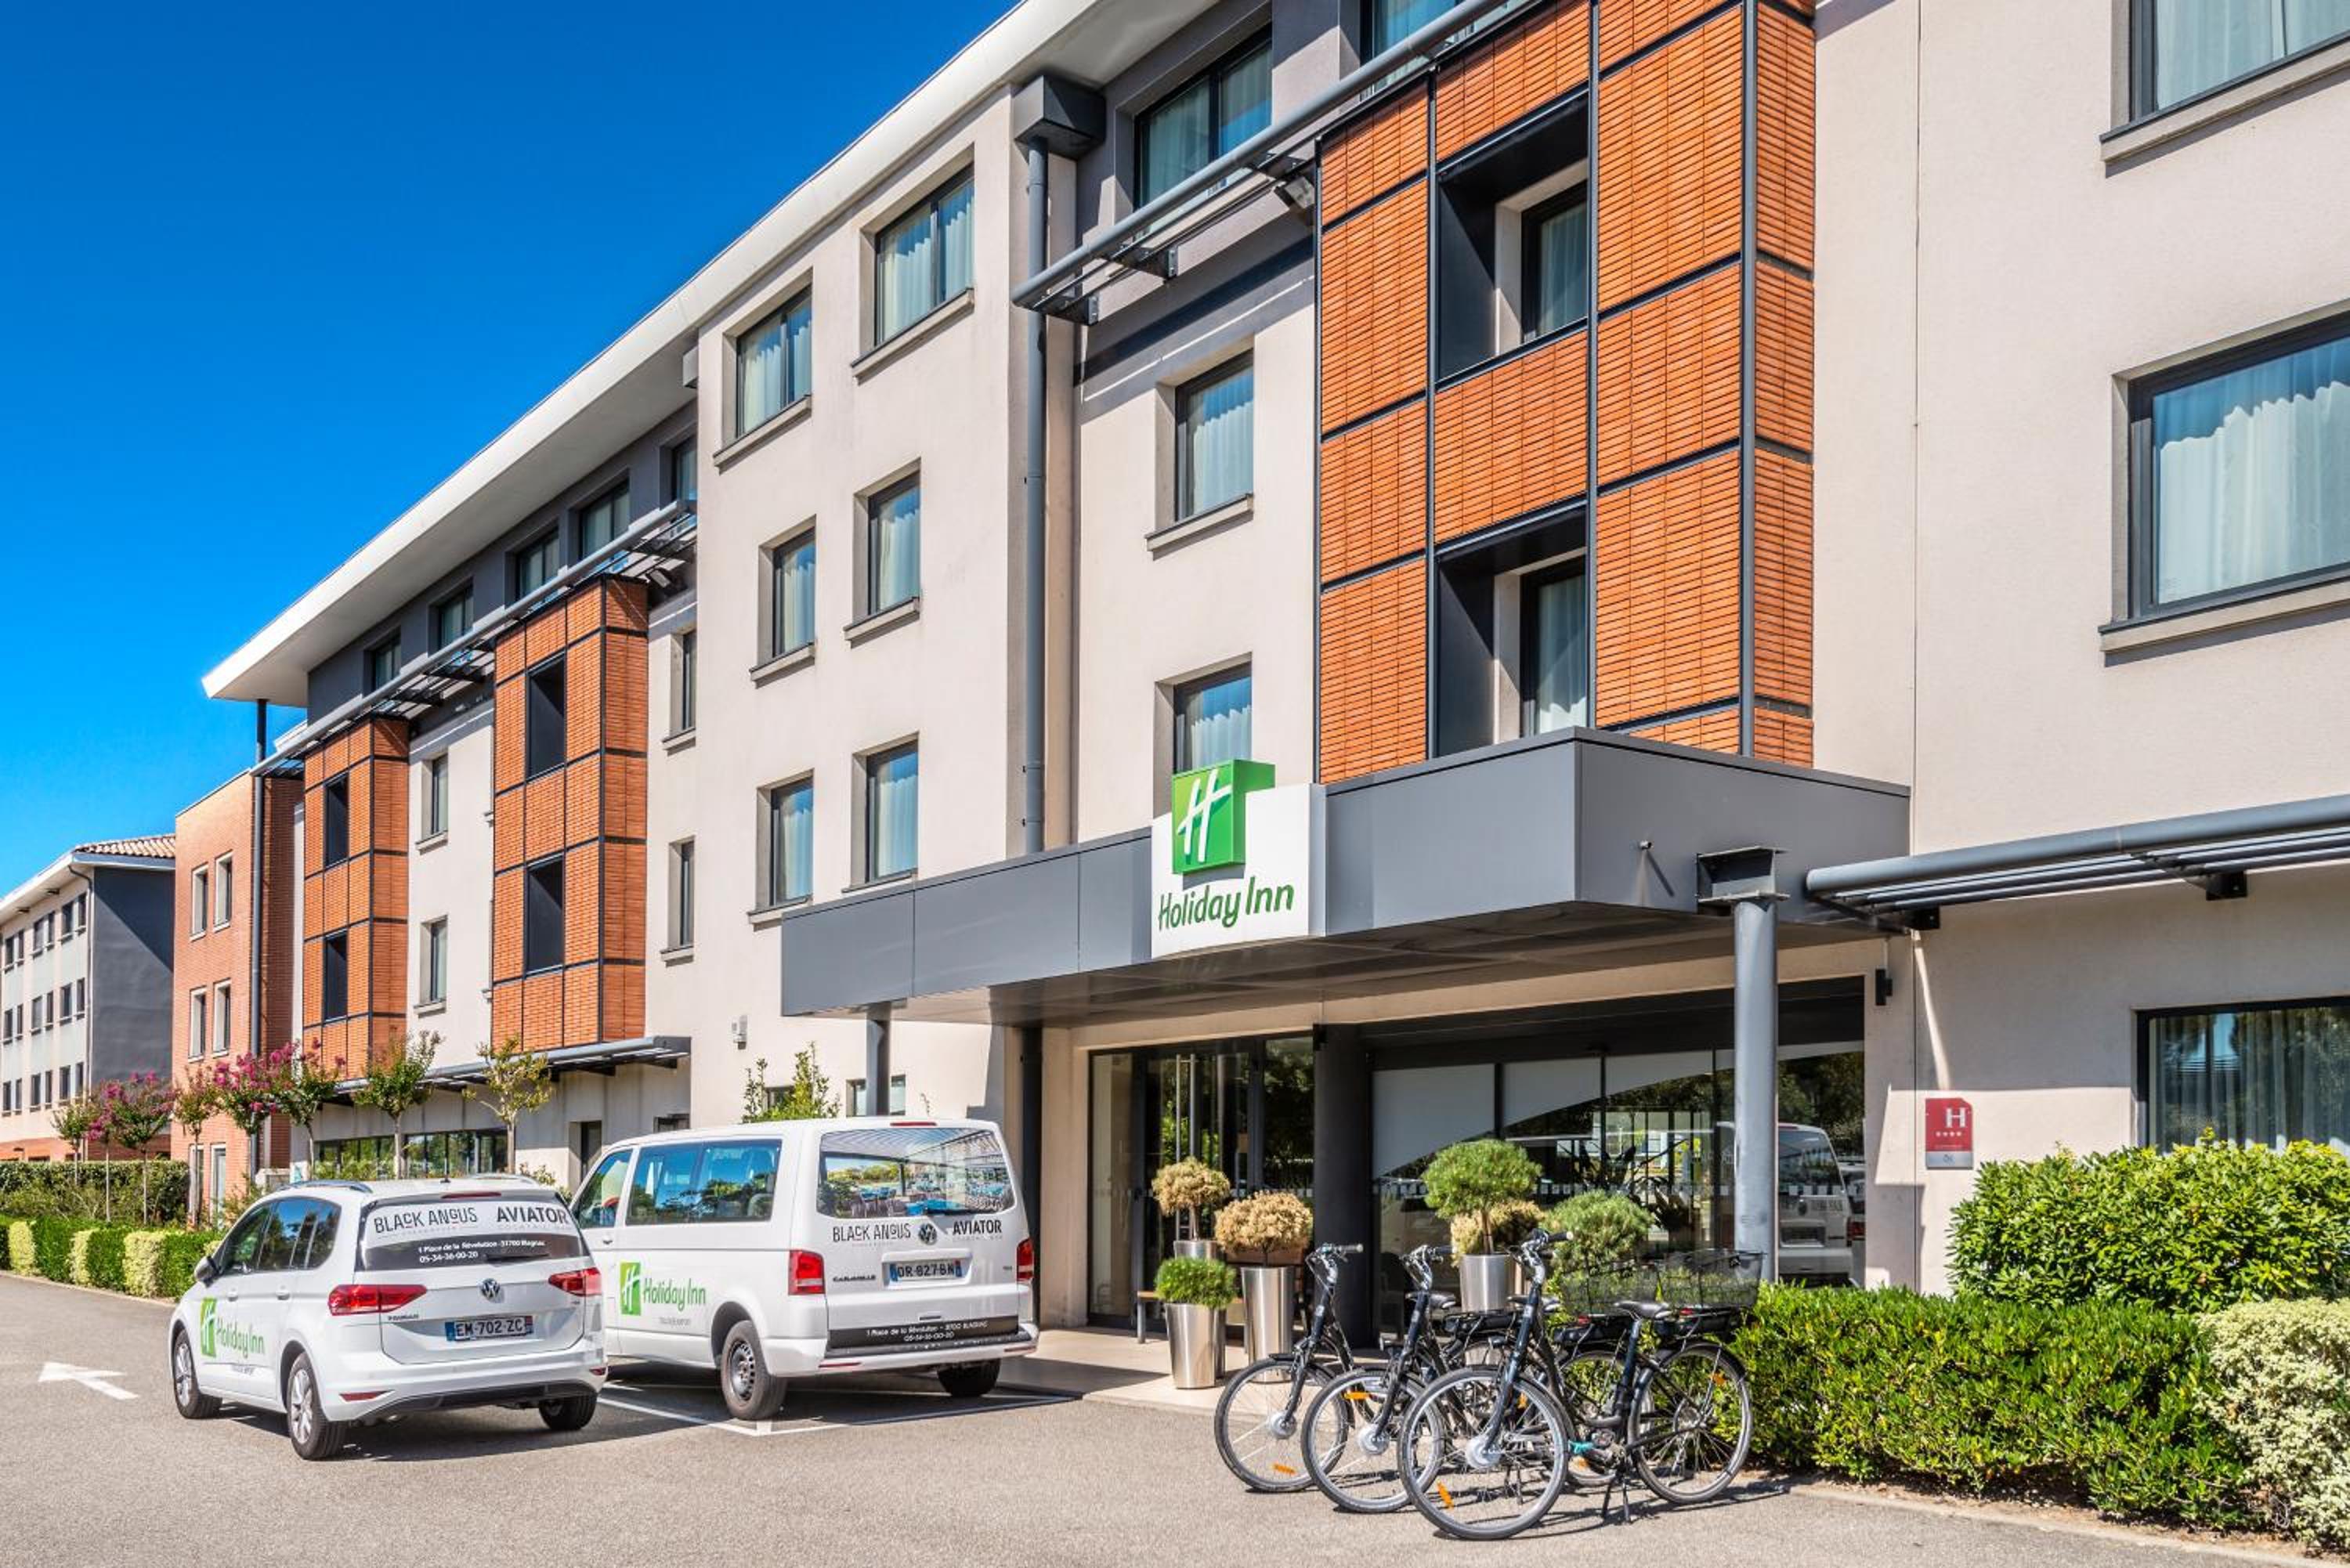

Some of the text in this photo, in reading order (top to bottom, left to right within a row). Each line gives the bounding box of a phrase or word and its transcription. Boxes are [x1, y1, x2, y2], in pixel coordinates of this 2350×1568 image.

[1158, 876, 1295, 930] Holiday Inn
[1946, 1107, 1966, 1128] H
[374, 1212, 425, 1234] BLACK
[428, 1207, 478, 1226] ANGUS
[497, 1206, 570, 1224] AVIATOR
[833, 1223, 911, 1242] BLACK ANGUS
[953, 1219, 1002, 1235] AVIATOR
[643, 1277, 706, 1312] Holiday Inn
